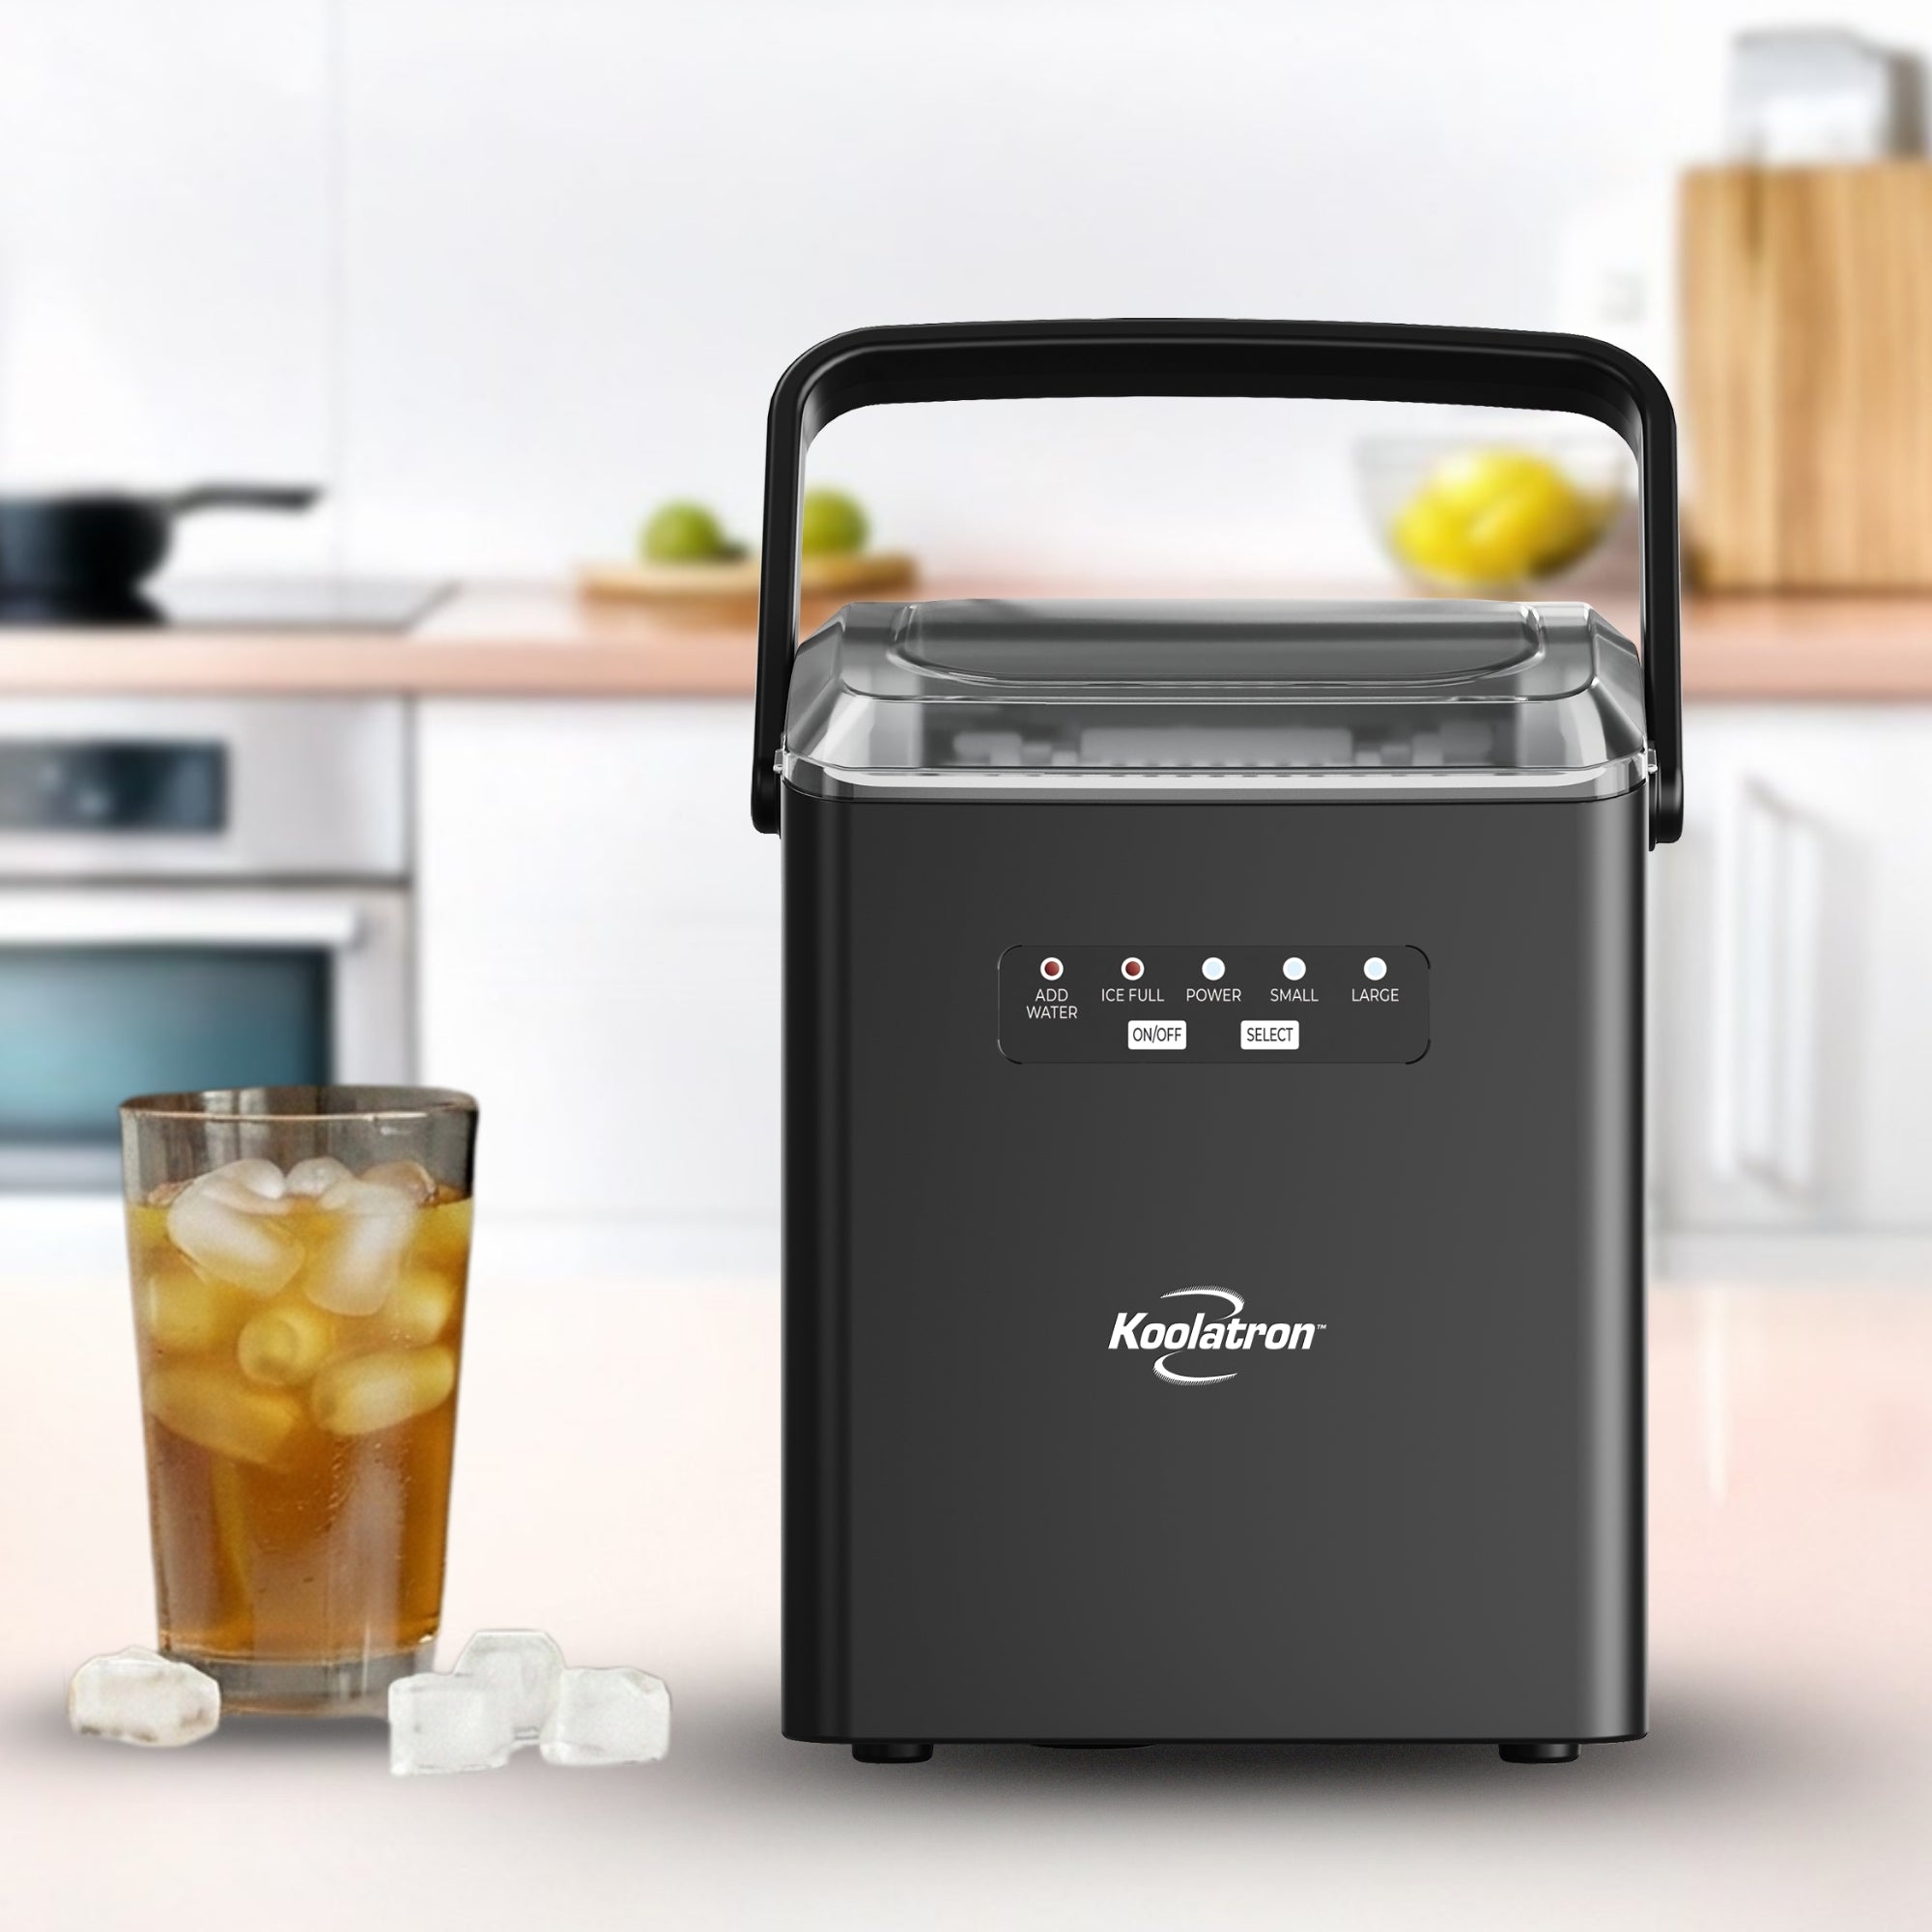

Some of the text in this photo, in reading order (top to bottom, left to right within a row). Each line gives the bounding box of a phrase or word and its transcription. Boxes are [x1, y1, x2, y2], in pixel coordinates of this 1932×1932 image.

[1035, 987, 1068, 1003] ADD
[1101, 987, 1165, 1003] ICE FULL
[1186, 987, 1242, 1003] POWER
[1269, 987, 1320, 1003] SMALL
[1351, 987, 1400, 1003] LARGE
[1026, 1005, 1078, 1020] WATER
[1131, 1025, 1182, 1043] ON/OFF
[1246, 1026, 1294, 1042] SELECT
